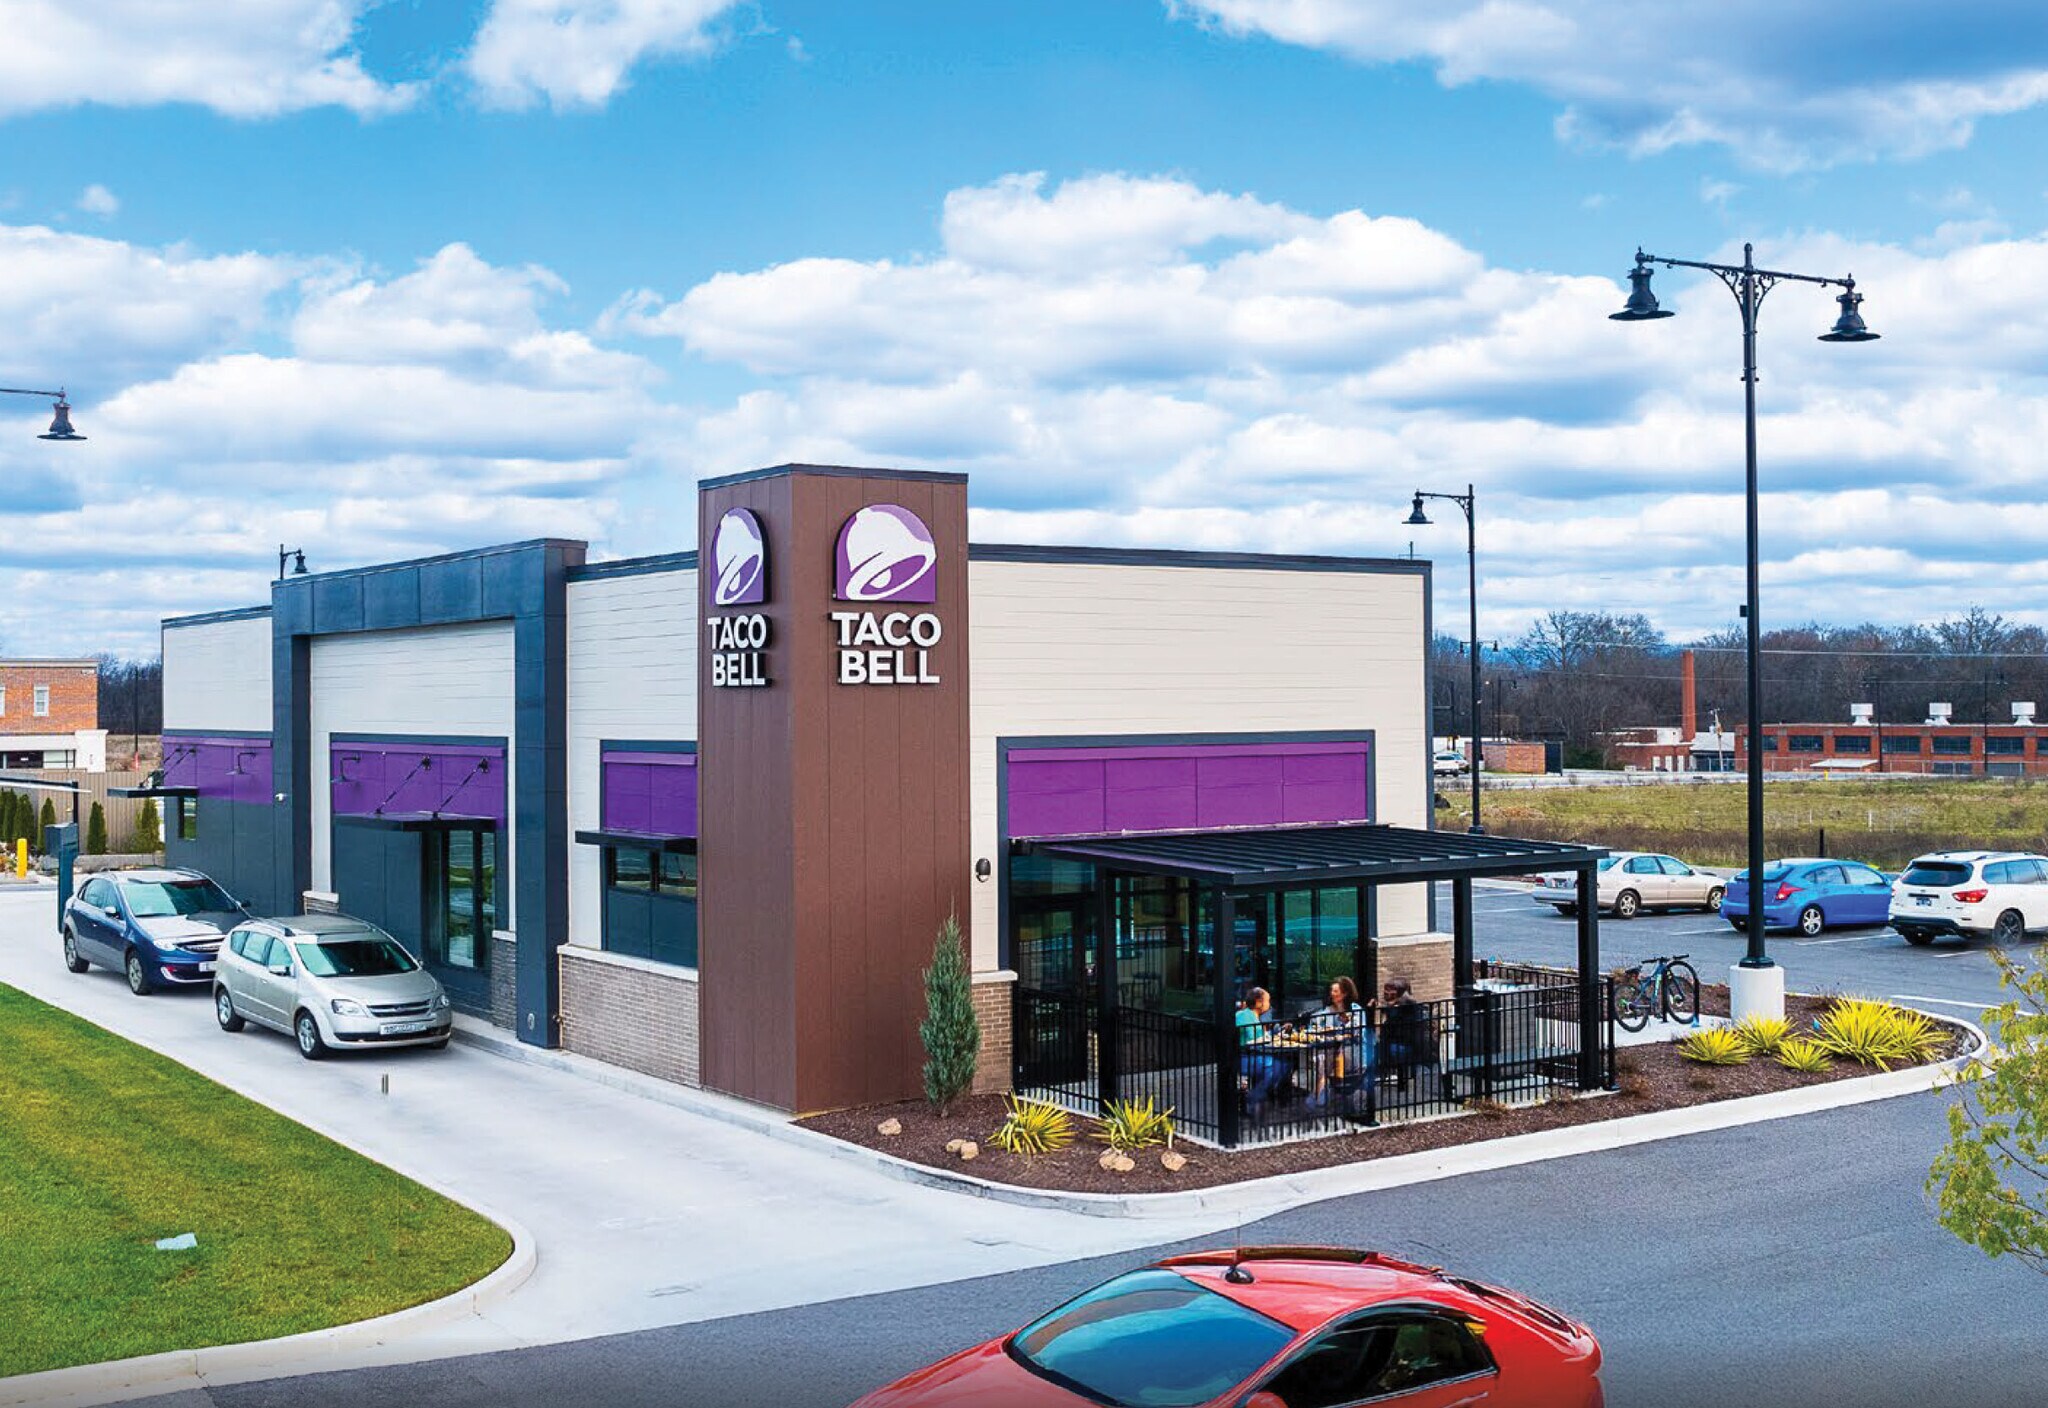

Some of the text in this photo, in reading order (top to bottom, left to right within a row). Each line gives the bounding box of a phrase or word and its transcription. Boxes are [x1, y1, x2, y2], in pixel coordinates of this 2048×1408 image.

[707, 614, 766, 649] TACO
[832, 612, 941, 646] TACO
[712, 652, 765, 686] BELL
[841, 650, 940, 683] BELL
